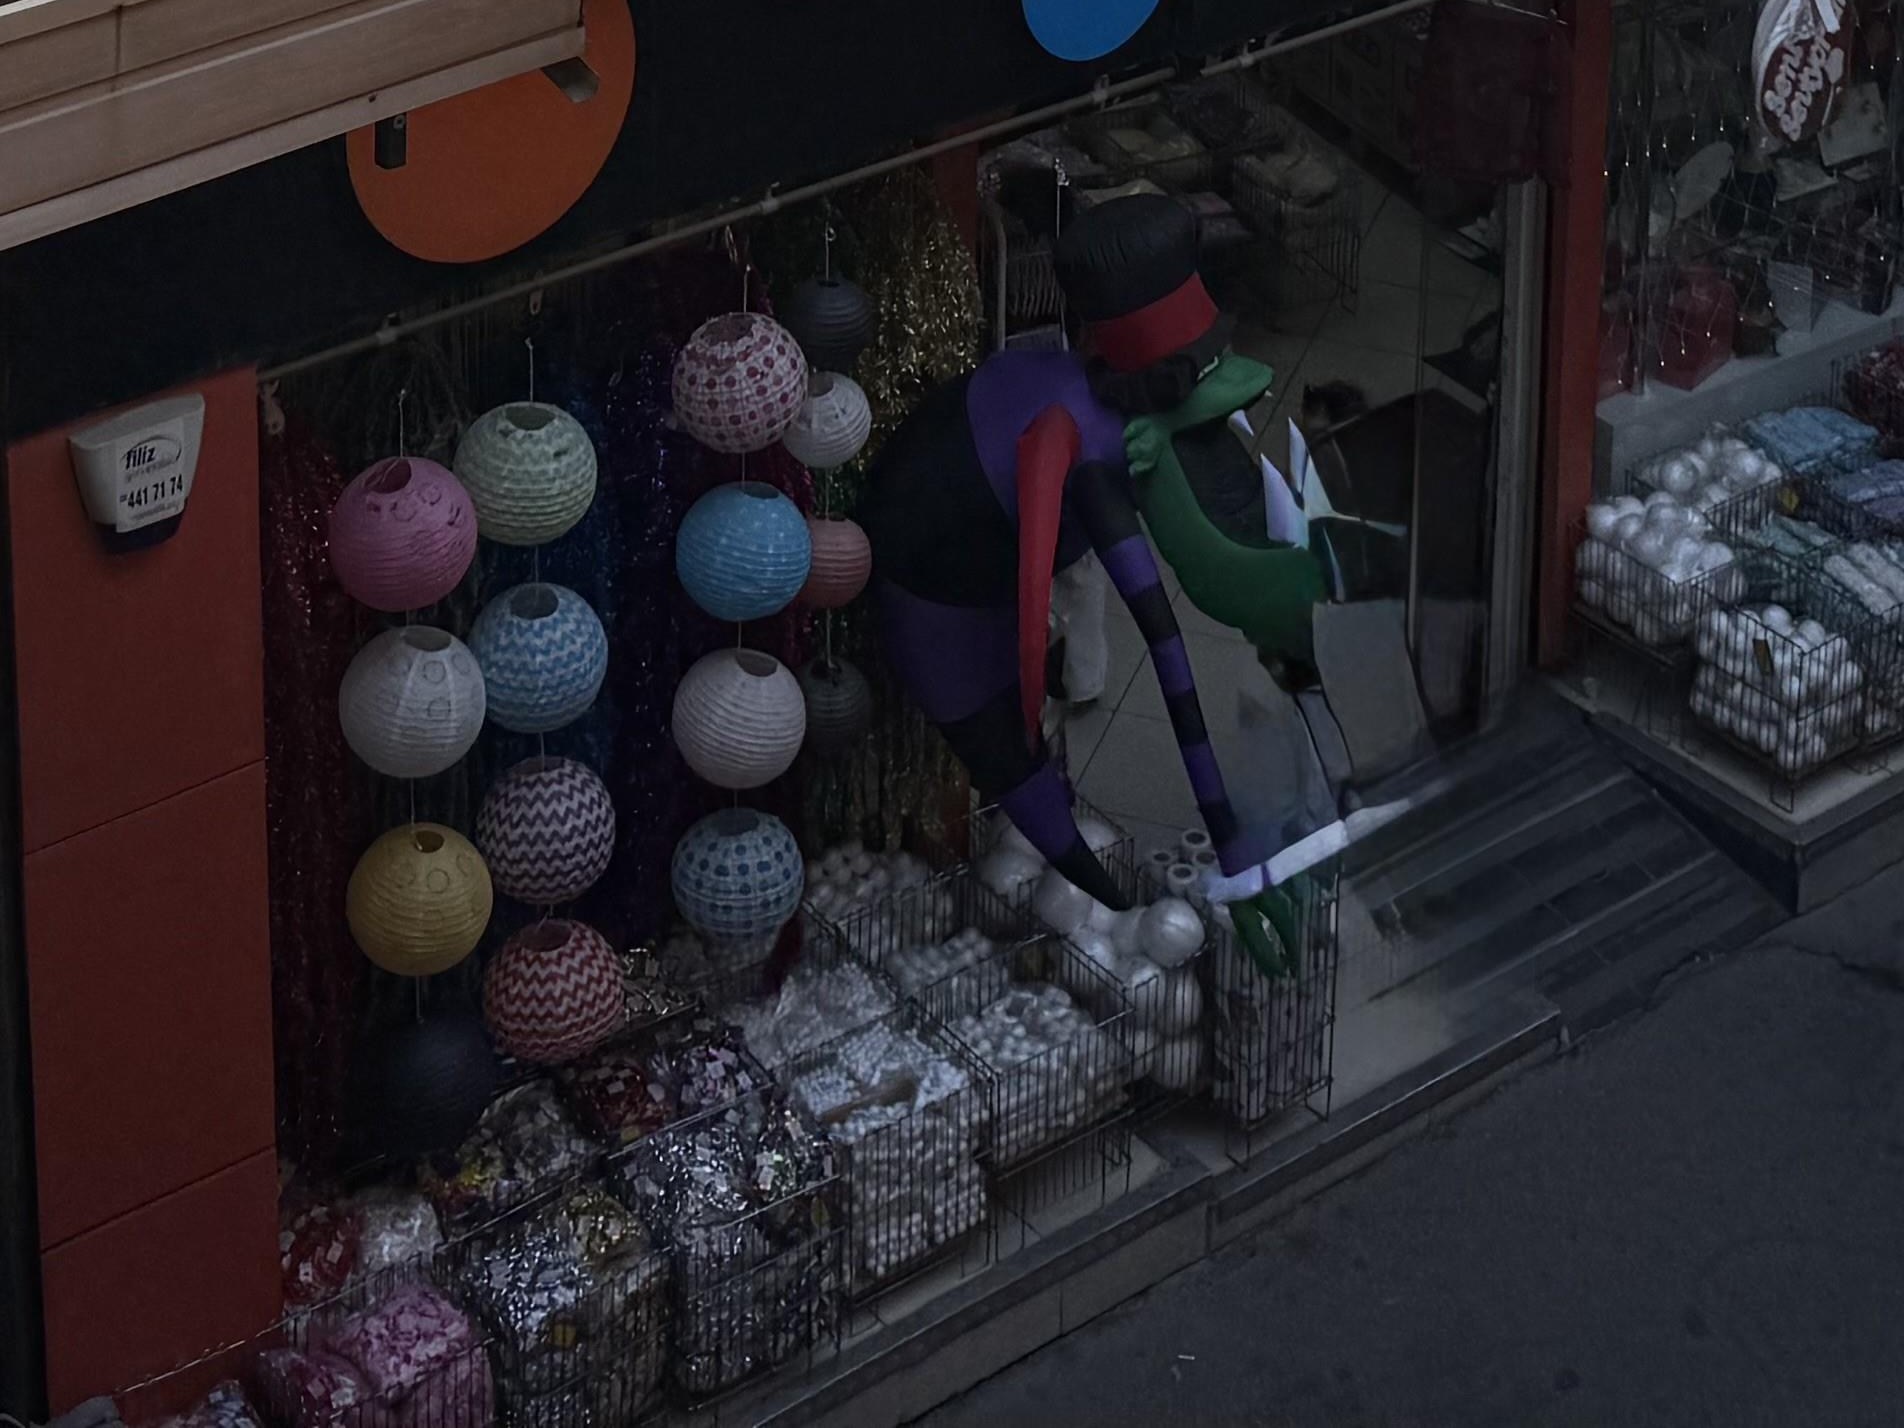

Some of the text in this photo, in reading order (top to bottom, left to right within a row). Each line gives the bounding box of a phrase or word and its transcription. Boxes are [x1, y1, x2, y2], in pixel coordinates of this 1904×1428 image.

[127, 474, 183, 508] 441 71 74
